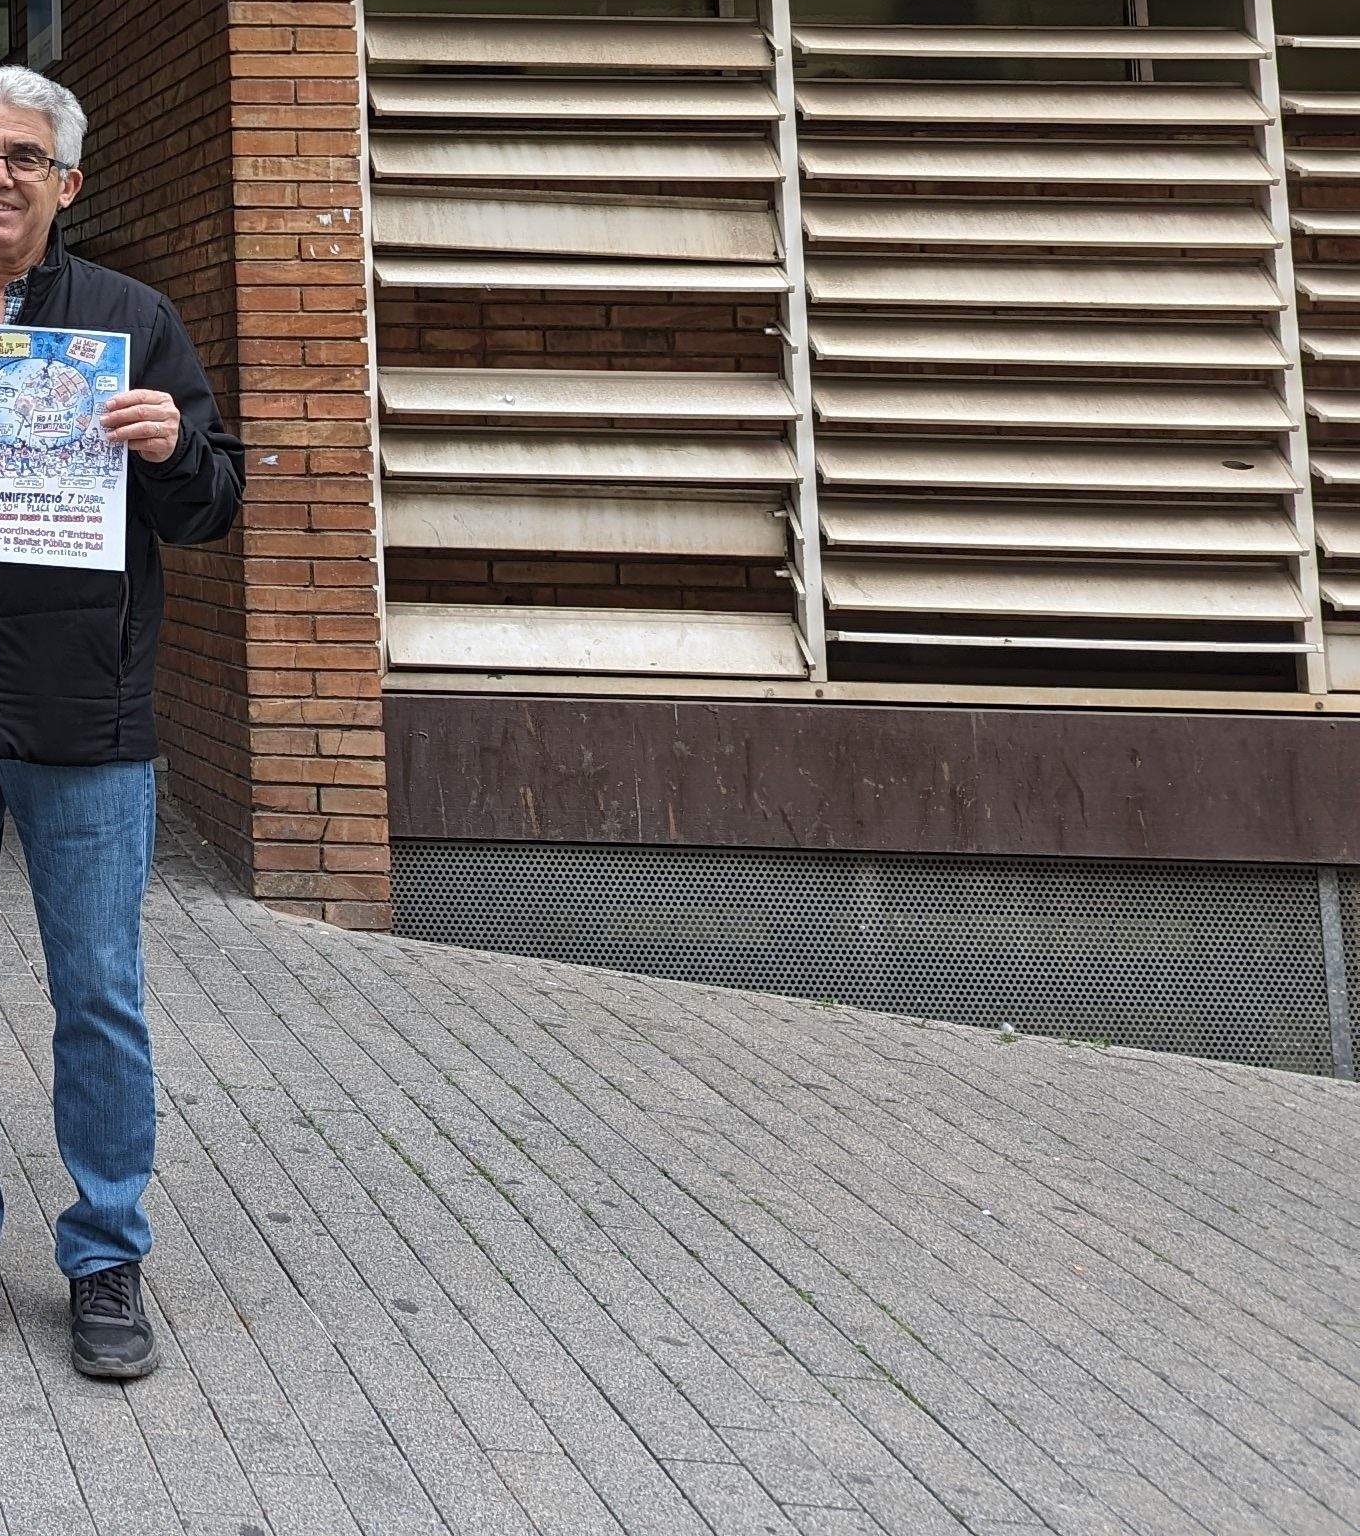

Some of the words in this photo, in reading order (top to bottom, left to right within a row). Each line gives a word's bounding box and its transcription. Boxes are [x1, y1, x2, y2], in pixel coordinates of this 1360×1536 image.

[67, 493, 75, 503] 7
[13, 537, 41, 546] Sanitat
[43, 539, 70, 549] Pública
[85, 541, 103, 550] Rubí
[47, 549, 88, 557] entitats
